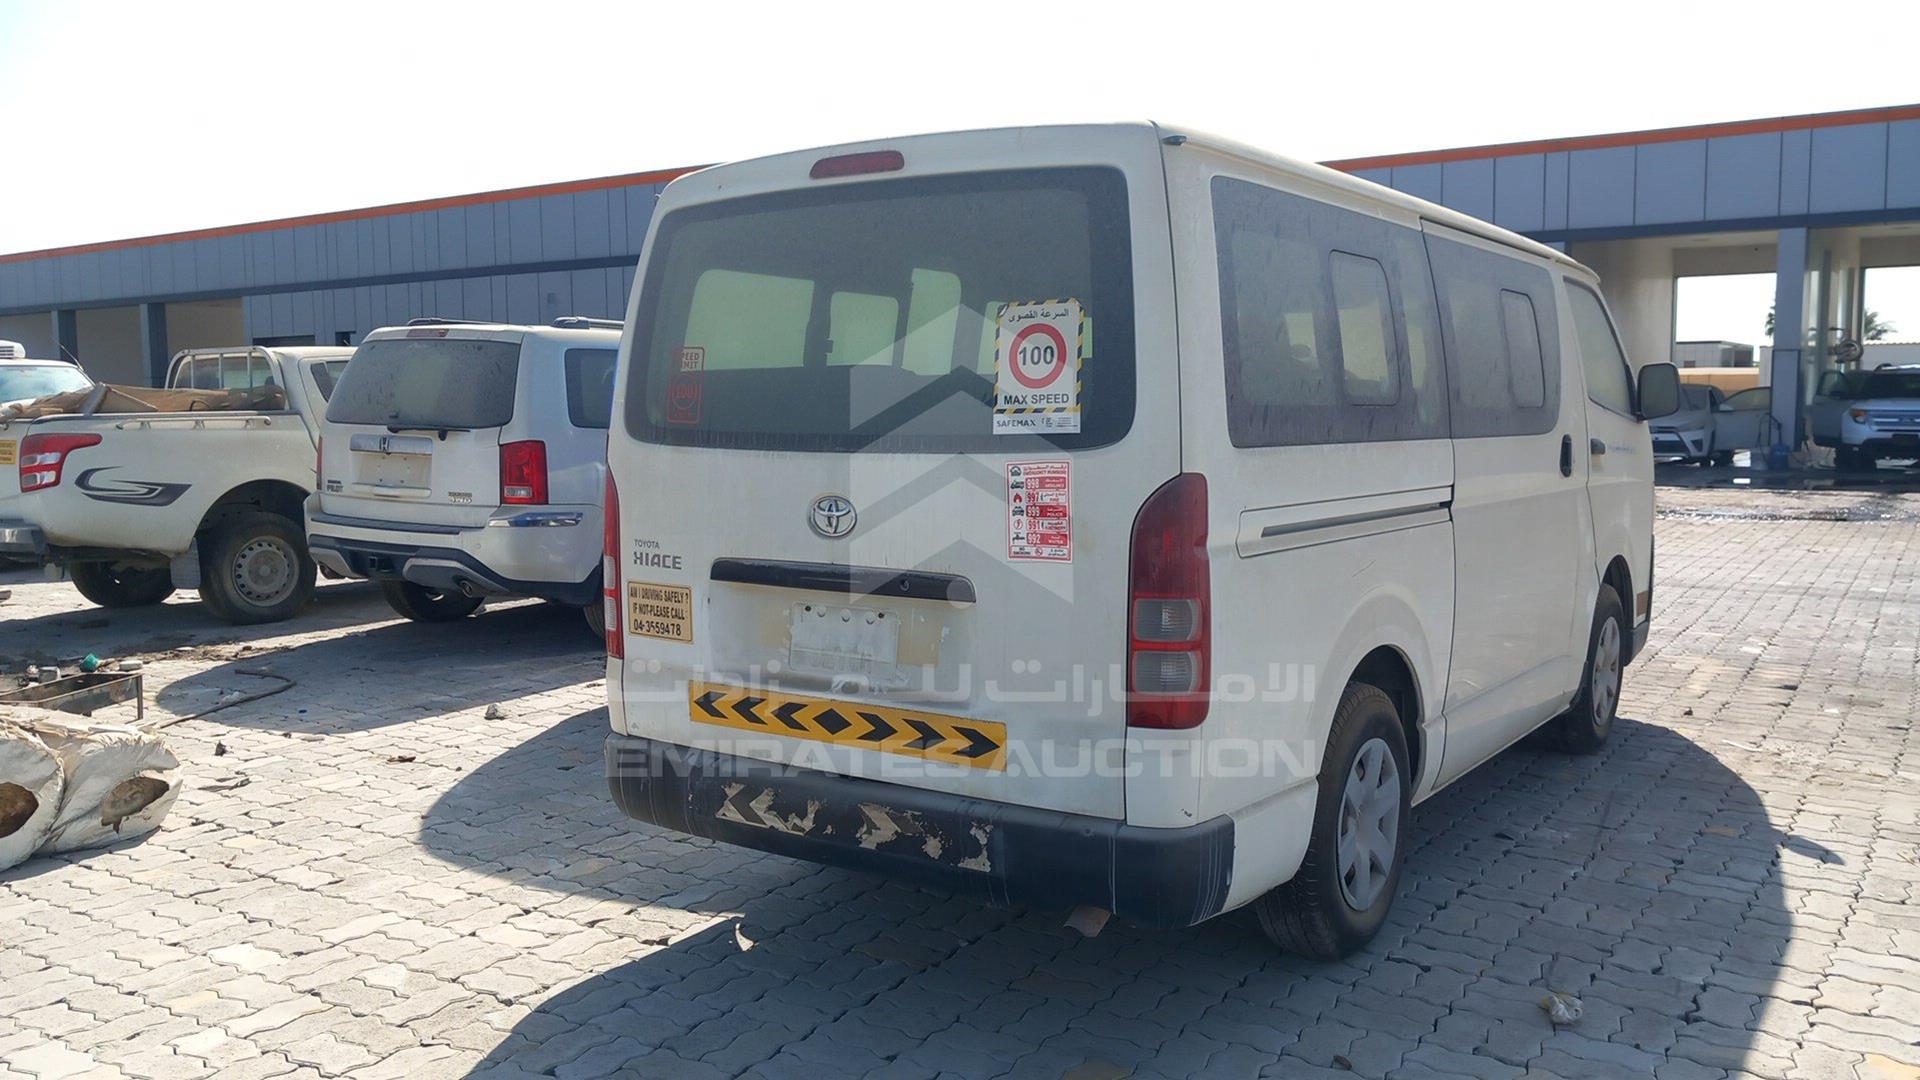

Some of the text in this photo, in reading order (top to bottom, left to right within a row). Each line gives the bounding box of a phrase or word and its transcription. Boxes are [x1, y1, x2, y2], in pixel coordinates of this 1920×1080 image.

[1008, 308, 1069, 322] السرعة القصوى
[1018, 345, 1055, 367] 100
[1003, 393, 1070, 405] MAX SPEED
[996, 419, 1036, 428] SAFEMAX
[634, 539, 660, 549] TOYOTA
[1028, 533, 1041, 544] 992
[633, 551, 682, 570] HIACE
[641, 588, 663, 601] DRIVING
[664, 590, 685, 603] SAFELY
[632, 602, 638, 614] IF
[670, 607, 685, 620] CALL
